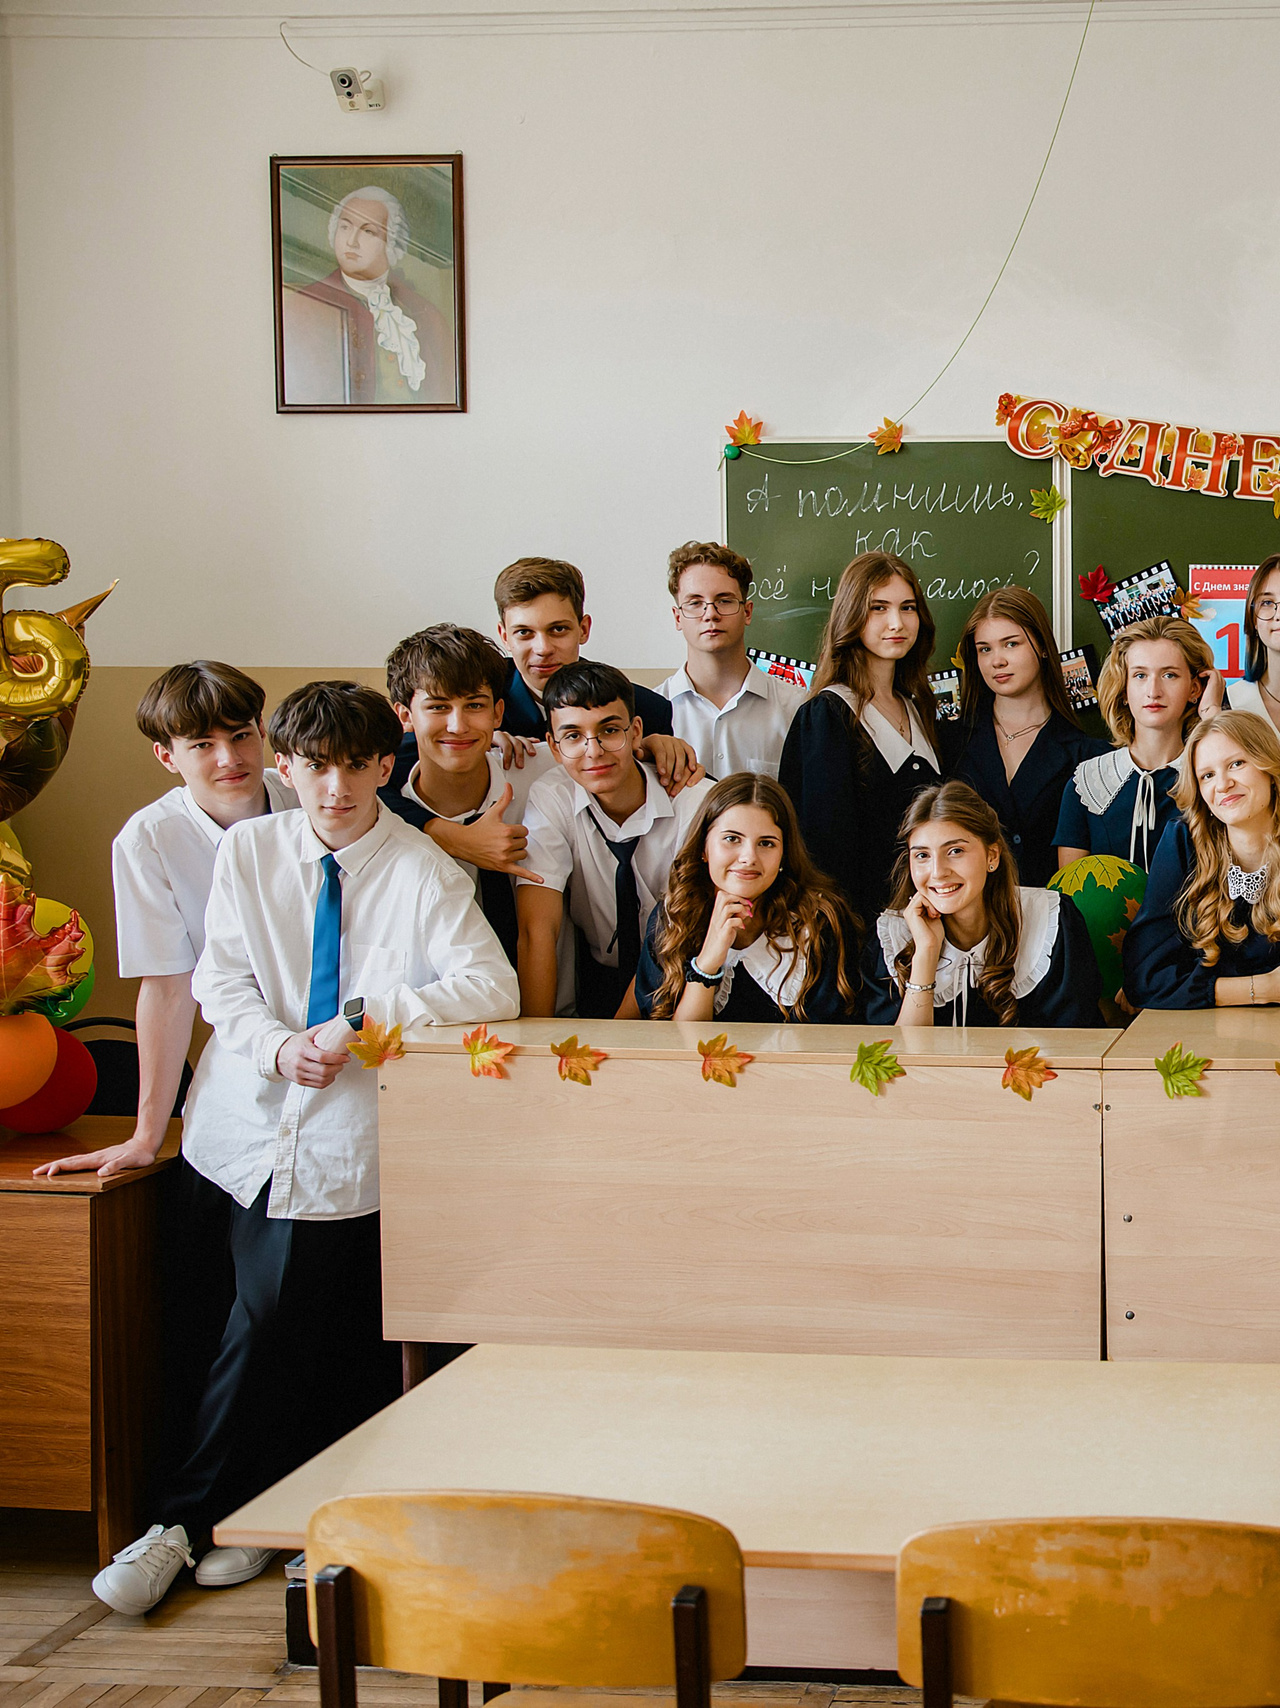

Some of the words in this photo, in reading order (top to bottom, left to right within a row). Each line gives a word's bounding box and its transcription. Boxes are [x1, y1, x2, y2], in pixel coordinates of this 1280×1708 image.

[1005, 398, 1069, 460] С
[746, 473, 781, 513] А
[798, 482, 1024, 517] помнишь,
[855, 527, 938, 559] как
[1193, 581, 1201, 591] С
[1202, 581, 1231, 593] Днем
[1215, 623, 1245, 679] 1
